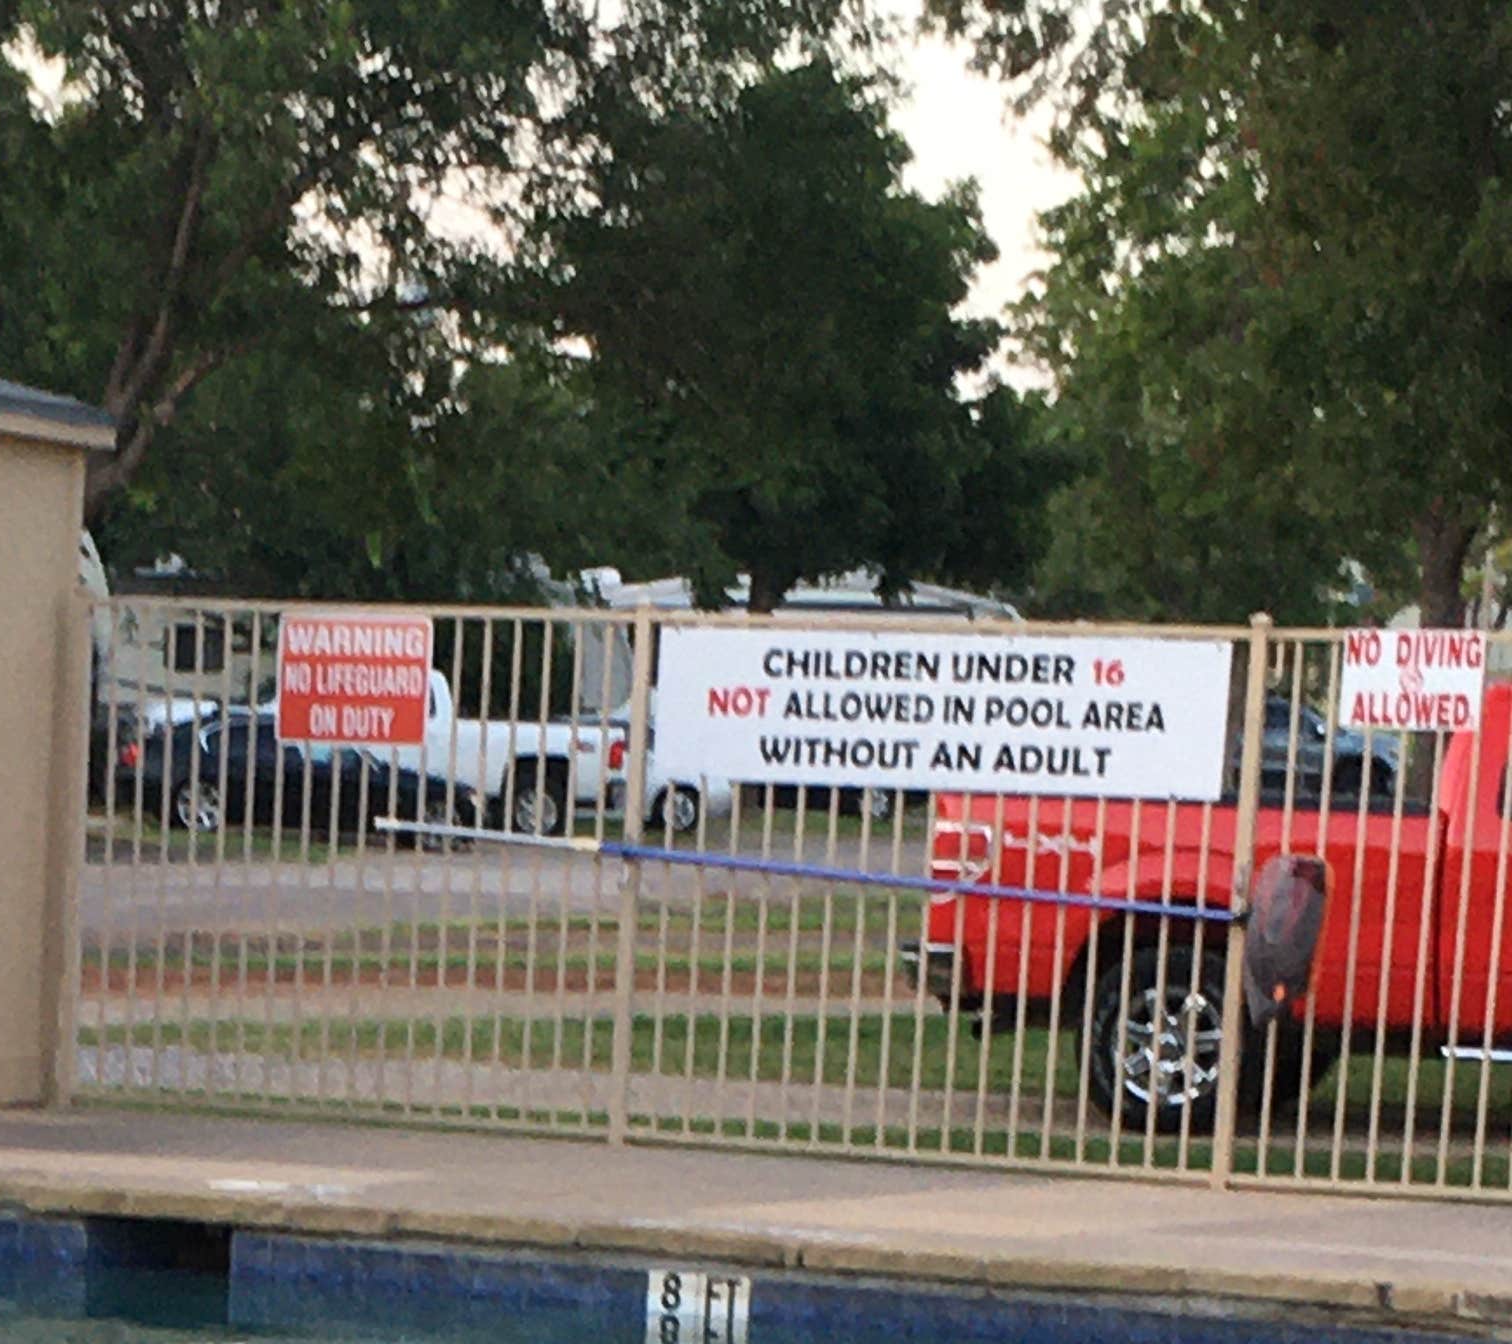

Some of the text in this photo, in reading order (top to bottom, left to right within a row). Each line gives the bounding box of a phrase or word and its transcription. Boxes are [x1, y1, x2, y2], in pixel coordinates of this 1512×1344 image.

[287, 623, 424, 658] WARNING
[1346, 631, 1483, 668] NO DIVING
[285, 662, 423, 698] NO LIFEGUARD
[763, 648, 1126, 687] CHILDREN UNDER 16
[309, 703, 395, 738] ON DUTY
[707, 686, 1167, 733] NOT ALLOWED IN POOL AREA
[1351, 691, 1471, 727] ALLOWED
[759, 735, 1113, 778] WITHOUT AN ADULT
